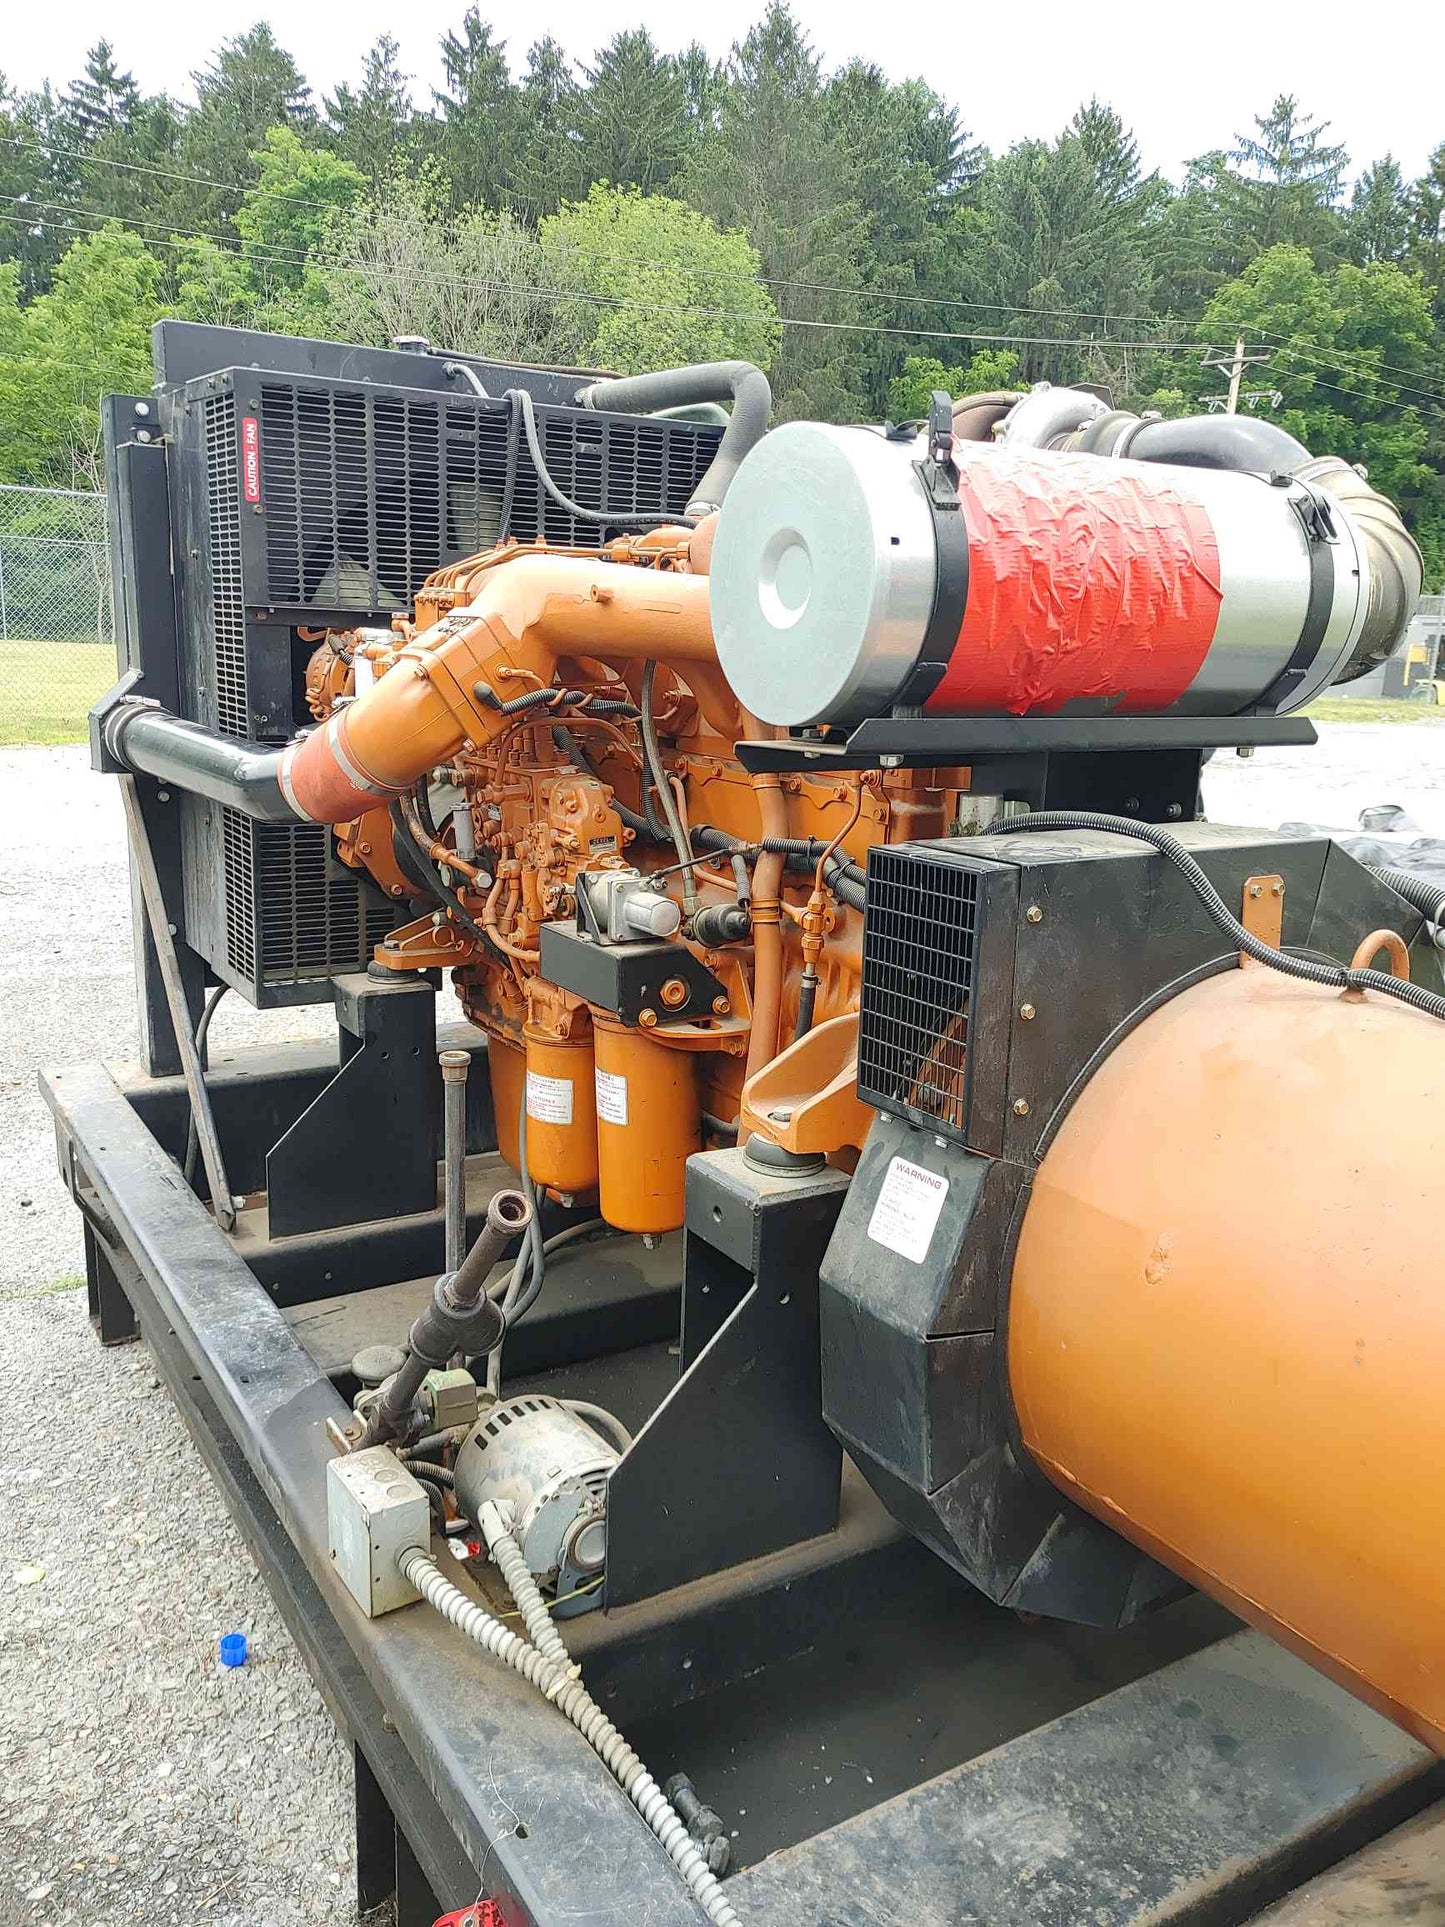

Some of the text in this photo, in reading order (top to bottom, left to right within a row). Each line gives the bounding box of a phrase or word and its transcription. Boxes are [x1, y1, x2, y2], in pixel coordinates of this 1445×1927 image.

[246, 423, 255, 444] FAN
[247, 451, 257, 496] CAUTION
[896, 1162, 942, 1190] WARNING
